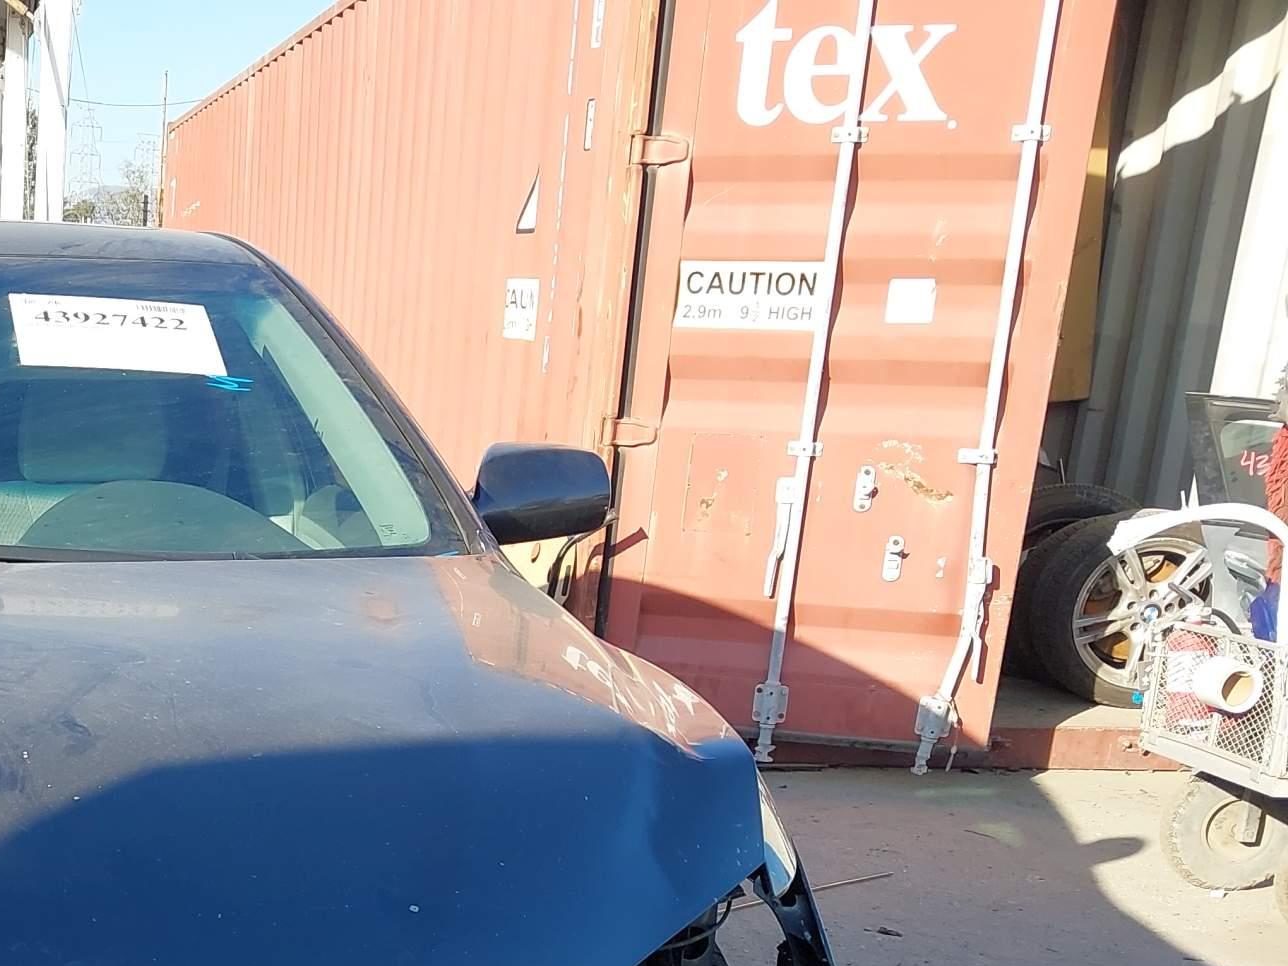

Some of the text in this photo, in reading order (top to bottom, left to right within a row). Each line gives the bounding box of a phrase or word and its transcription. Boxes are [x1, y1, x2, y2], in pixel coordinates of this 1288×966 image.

[686, 270, 818, 296] CAUTION
[33, 309, 188, 331] 43927422
[682, 304, 722, 319] 2.9m
[767, 306, 813, 321] HIGH
